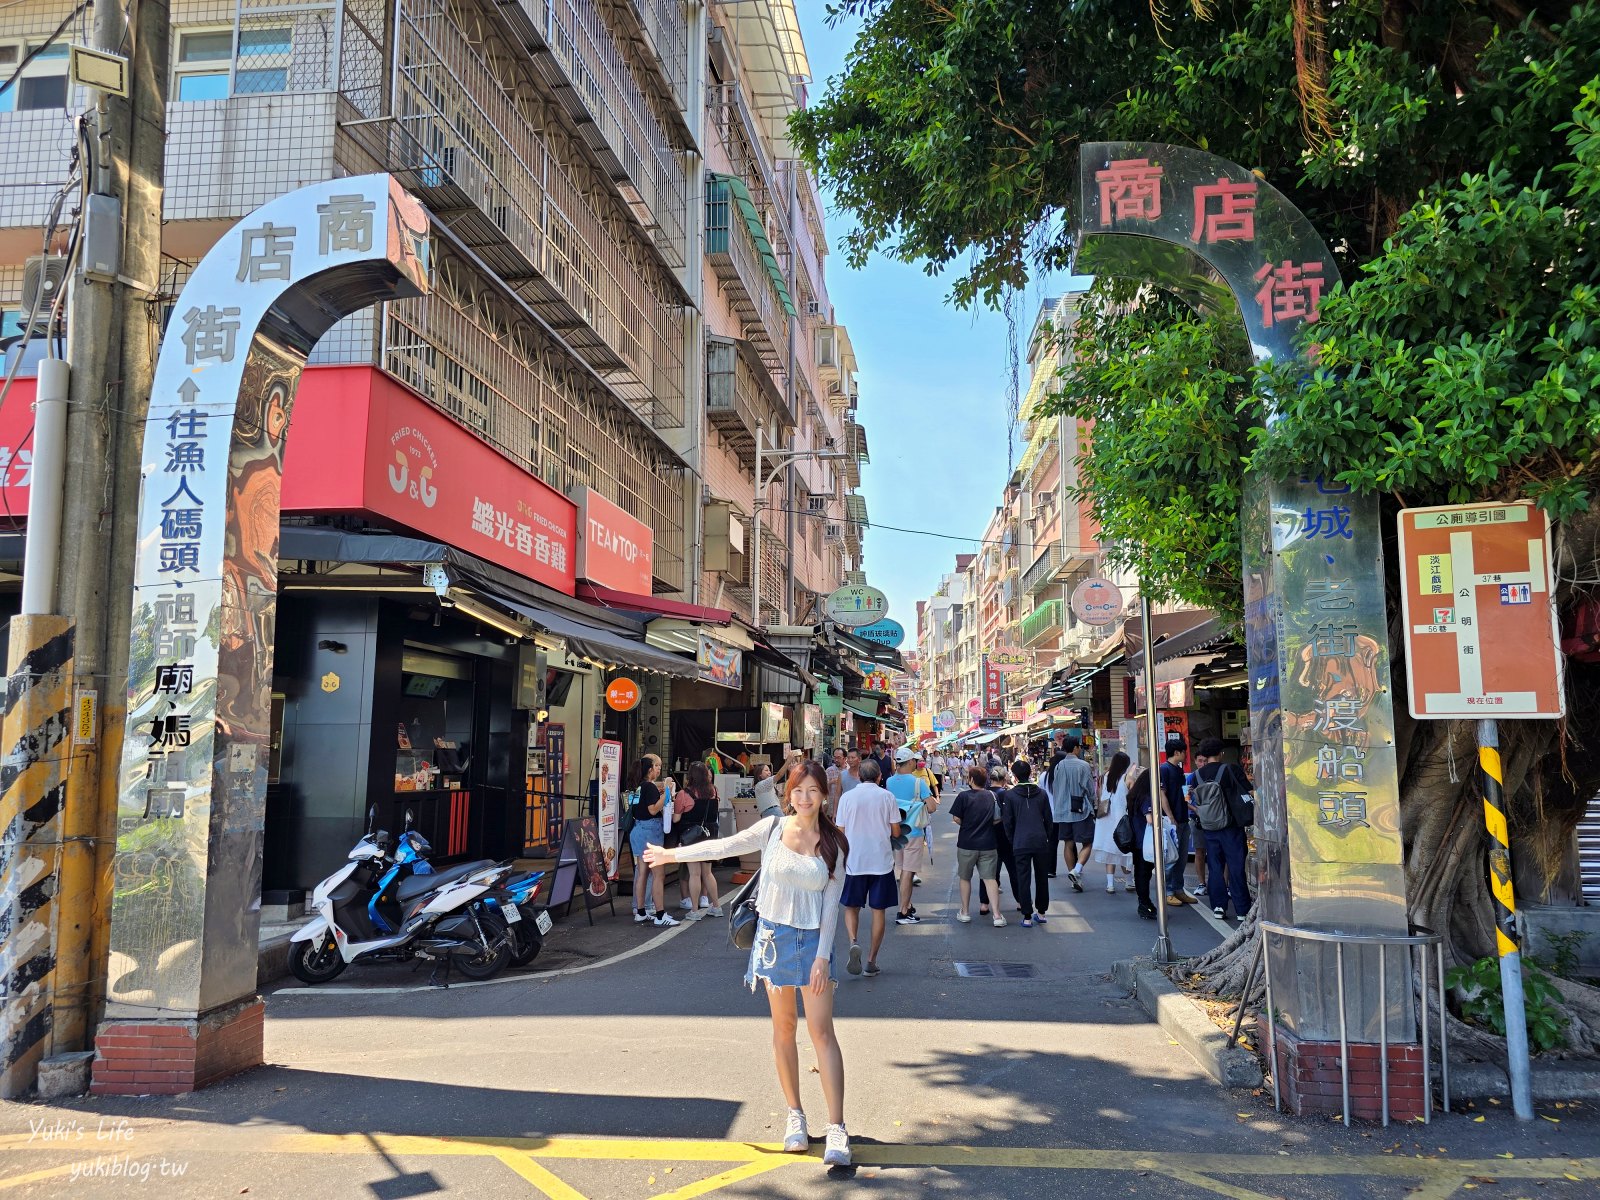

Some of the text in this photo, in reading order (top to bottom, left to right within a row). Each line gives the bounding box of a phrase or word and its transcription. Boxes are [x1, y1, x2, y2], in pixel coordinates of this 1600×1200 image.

[1095, 157, 1326, 329] 商店街
[181, 193, 376, 365] 商店街
[390, 426, 438, 469] FRIED CHICKEN
[533, 512, 549, 528] FRIED
[548, 520, 567, 539] CHICKEN
[589, 517, 612, 552] TEA
[618, 535, 639, 564] TOP
[850, 588, 864, 596] WC
[1429, 554, 1443, 594] 淡江戲院
[1482, 574, 1502, 583] 37 巷
[1428, 625, 1447, 633] 56 巷
[1459, 588, 1474, 655] 公明街
[1467, 697, 1504, 705] 現在位置
